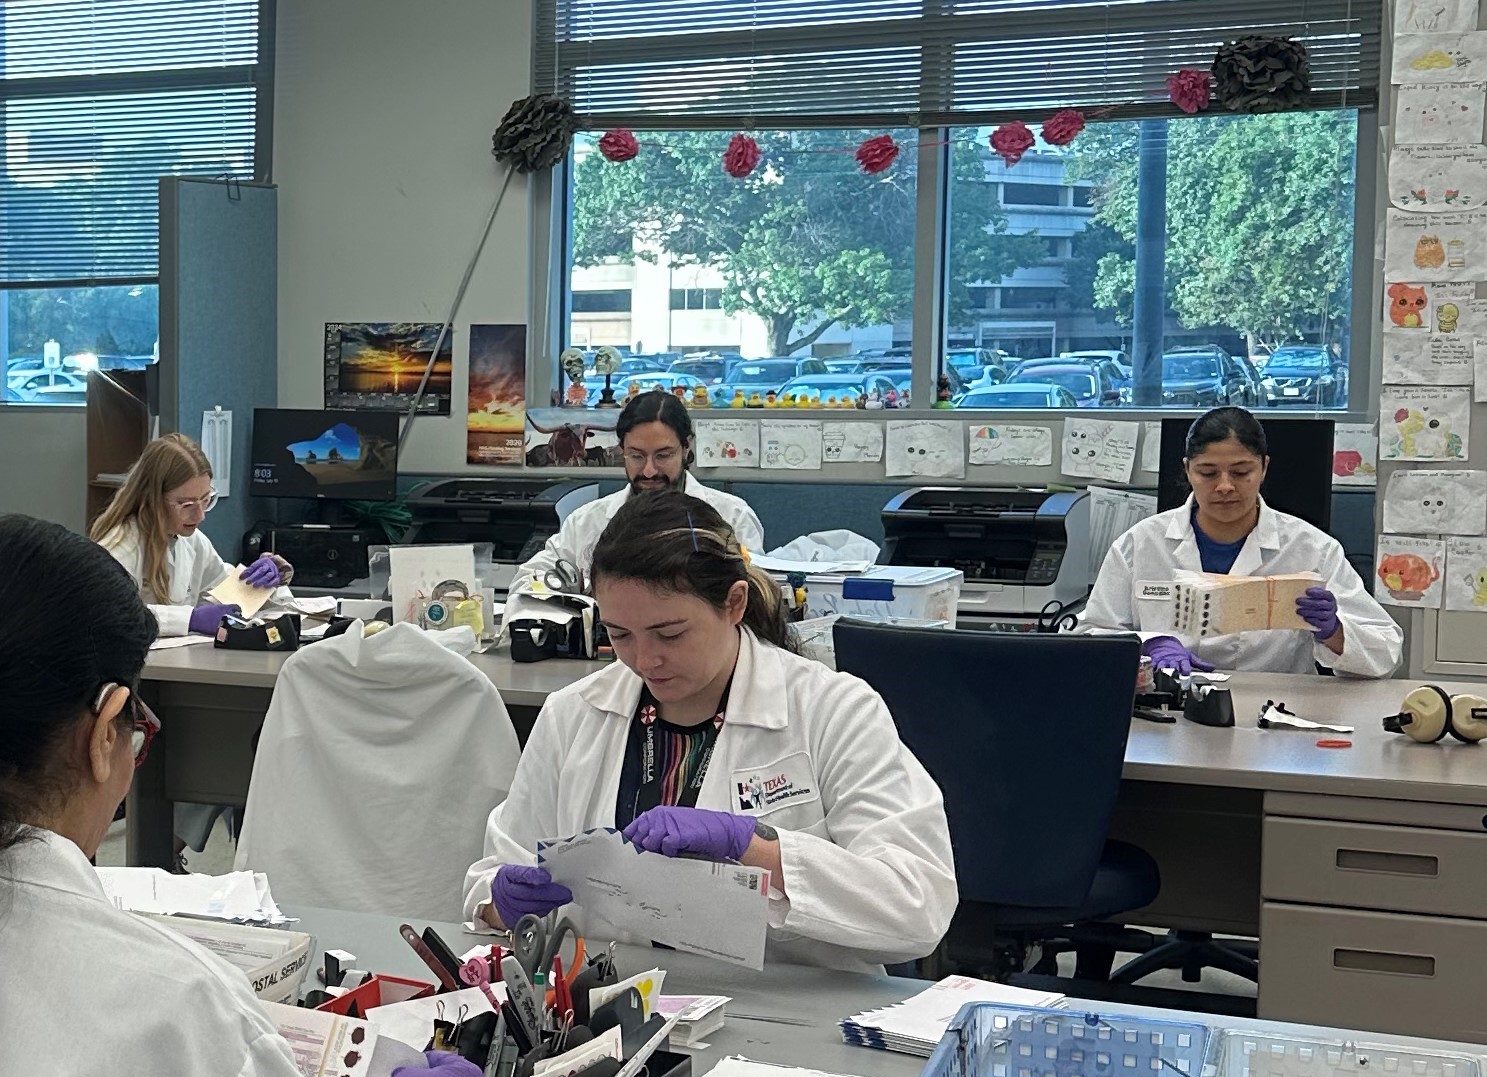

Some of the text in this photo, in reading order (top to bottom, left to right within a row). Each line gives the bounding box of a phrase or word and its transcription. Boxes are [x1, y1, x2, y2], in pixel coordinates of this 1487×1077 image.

[646, 726, 654, 783] UMBRELLA
[763, 774, 786, 792] TEXAS
[252, 970, 278, 993] OSTAL
